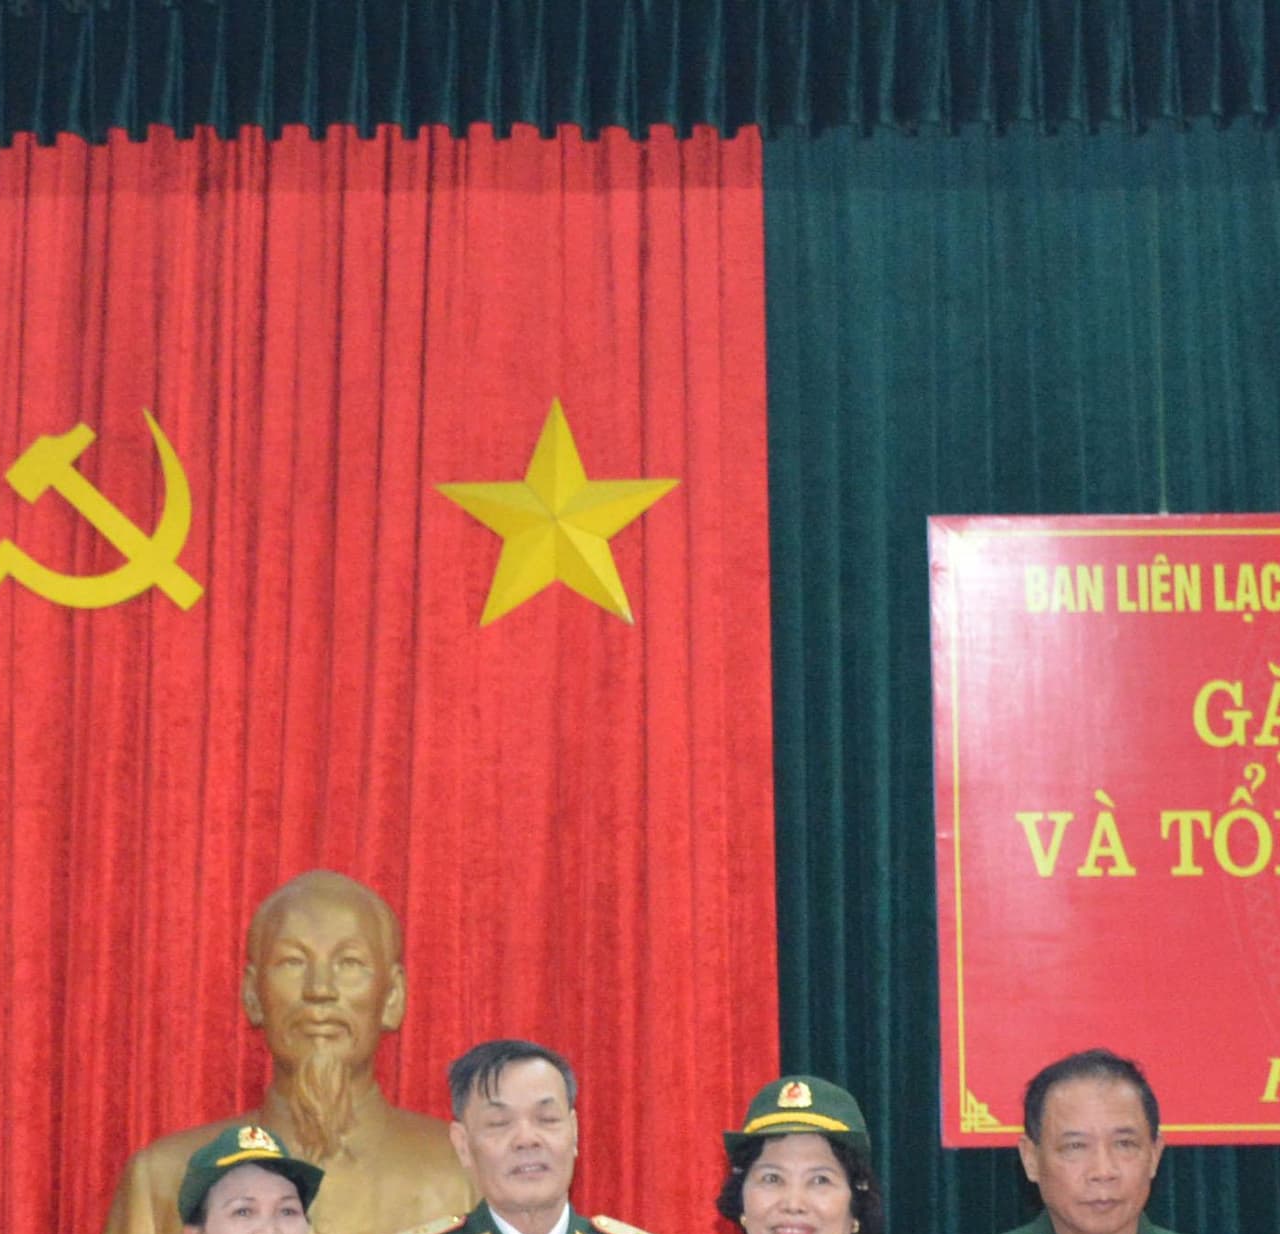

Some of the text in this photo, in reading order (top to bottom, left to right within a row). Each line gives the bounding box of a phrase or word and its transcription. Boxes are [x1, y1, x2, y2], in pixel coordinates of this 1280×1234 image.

[1023, 564, 1104, 613] BAN
[1118, 554, 1202, 612] LIÊN
[1018, 790, 1136, 877] VÀ
